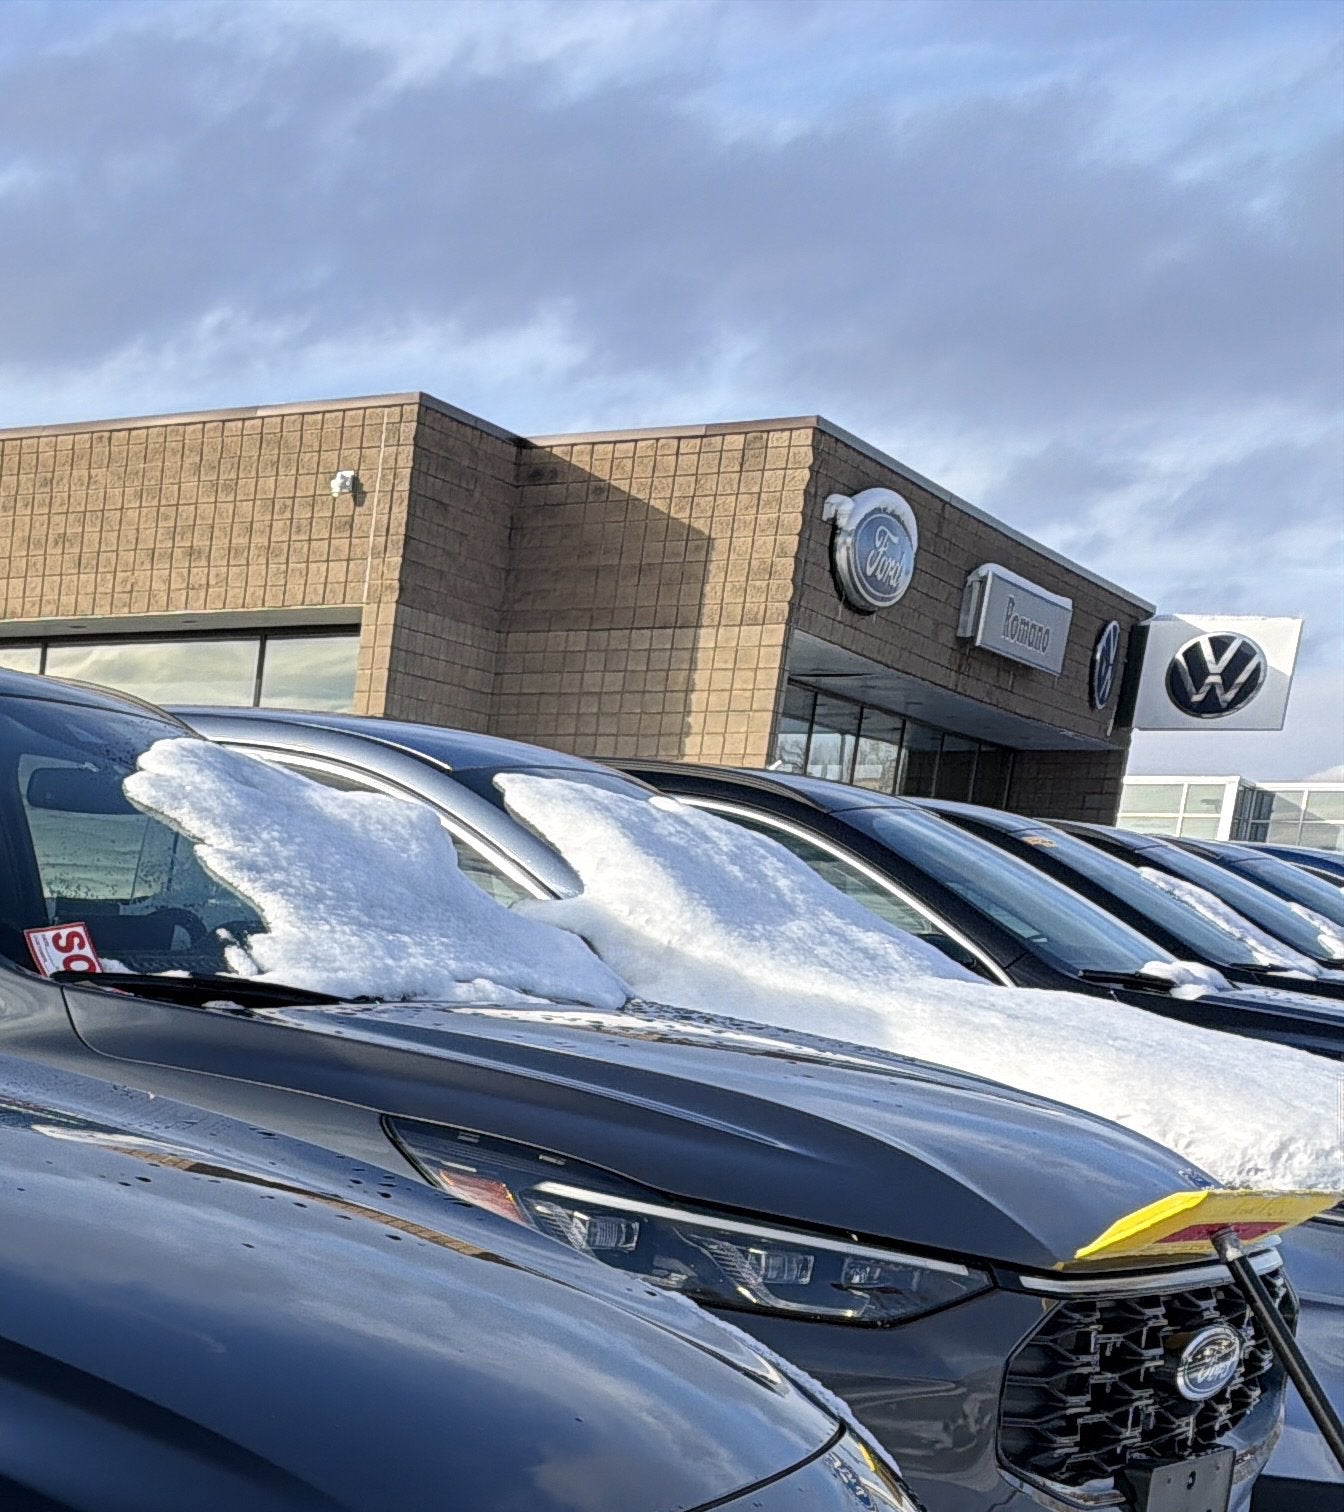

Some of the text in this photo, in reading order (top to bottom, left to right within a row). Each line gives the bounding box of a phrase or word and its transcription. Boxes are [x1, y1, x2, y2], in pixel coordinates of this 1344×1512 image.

[865, 525, 905, 588] Ford
[1002, 595, 1051, 653] Romano
[1172, 633, 1264, 713] VW
[52, 931, 97, 973] SO
